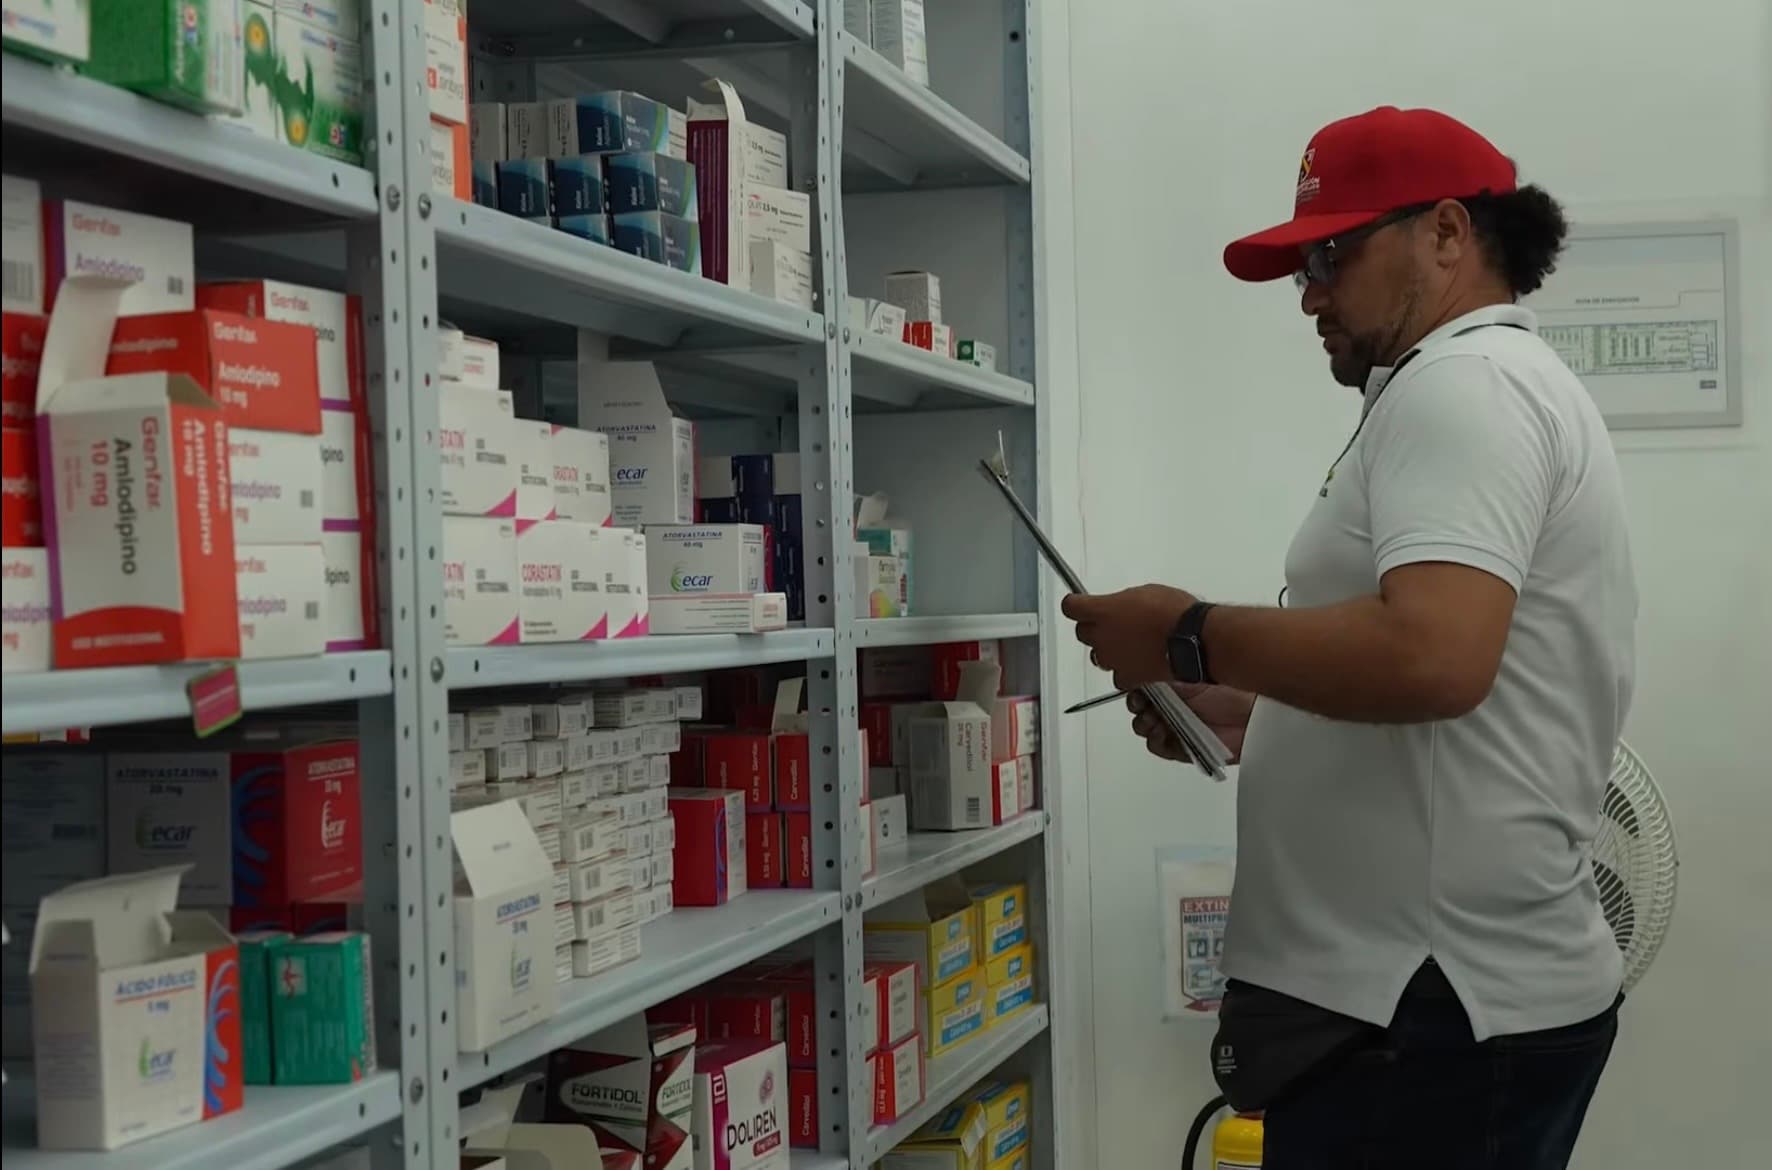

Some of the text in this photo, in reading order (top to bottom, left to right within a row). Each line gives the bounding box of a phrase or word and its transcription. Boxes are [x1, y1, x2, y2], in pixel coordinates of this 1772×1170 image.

[218, 360, 281, 390] Amlodipino
[142, 416, 163, 509] Genfar
[617, 466, 649, 481] ecar
[195, 418, 212, 556] Amlodipino
[114, 437, 138, 575] Amlodipino
[682, 573, 713, 588] ecar
[965, 721, 974, 773] Carvedilol
[151, 825, 197, 842] ecar
[571, 1083, 642, 1105] FORTIDOL
[727, 1106, 777, 1151] DOLIREN
